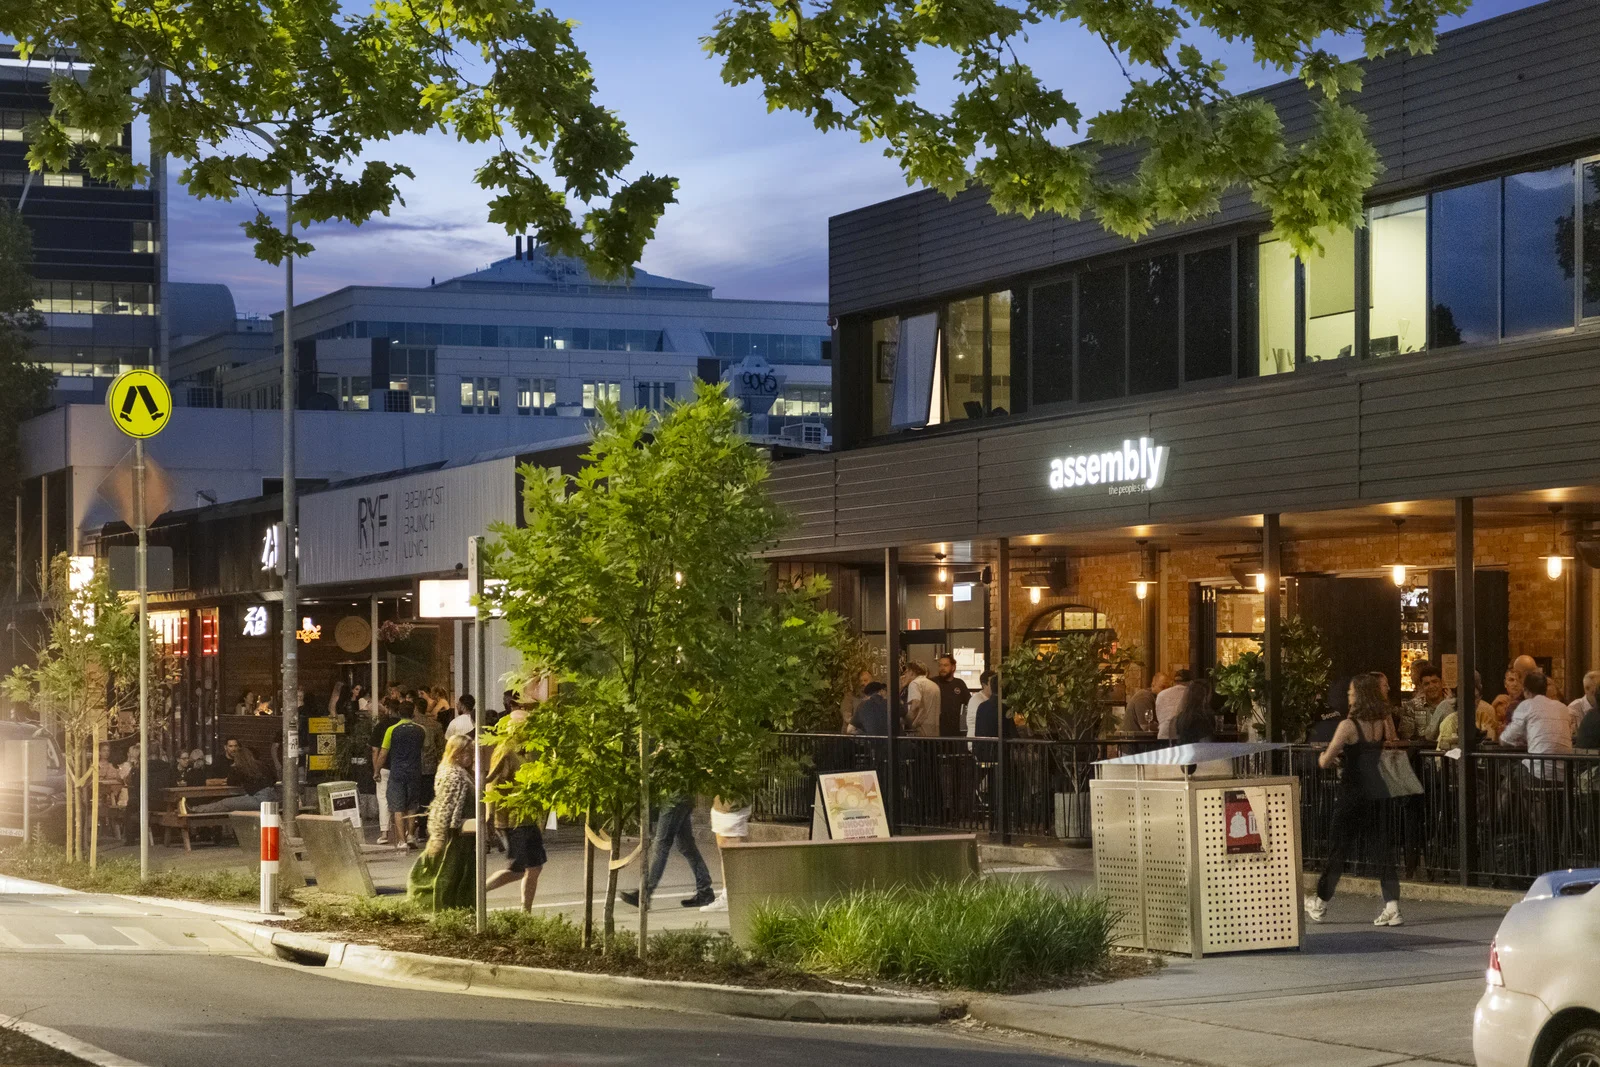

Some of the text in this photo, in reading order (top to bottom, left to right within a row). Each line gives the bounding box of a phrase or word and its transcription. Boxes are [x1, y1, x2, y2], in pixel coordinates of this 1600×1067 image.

[1050, 437, 1166, 489] assembly
[1108, 486, 1118, 495] the
[358, 493, 389, 549] RYE
[404, 513, 435, 534] BRUNCH
[404, 539, 429, 559] LUNCH
